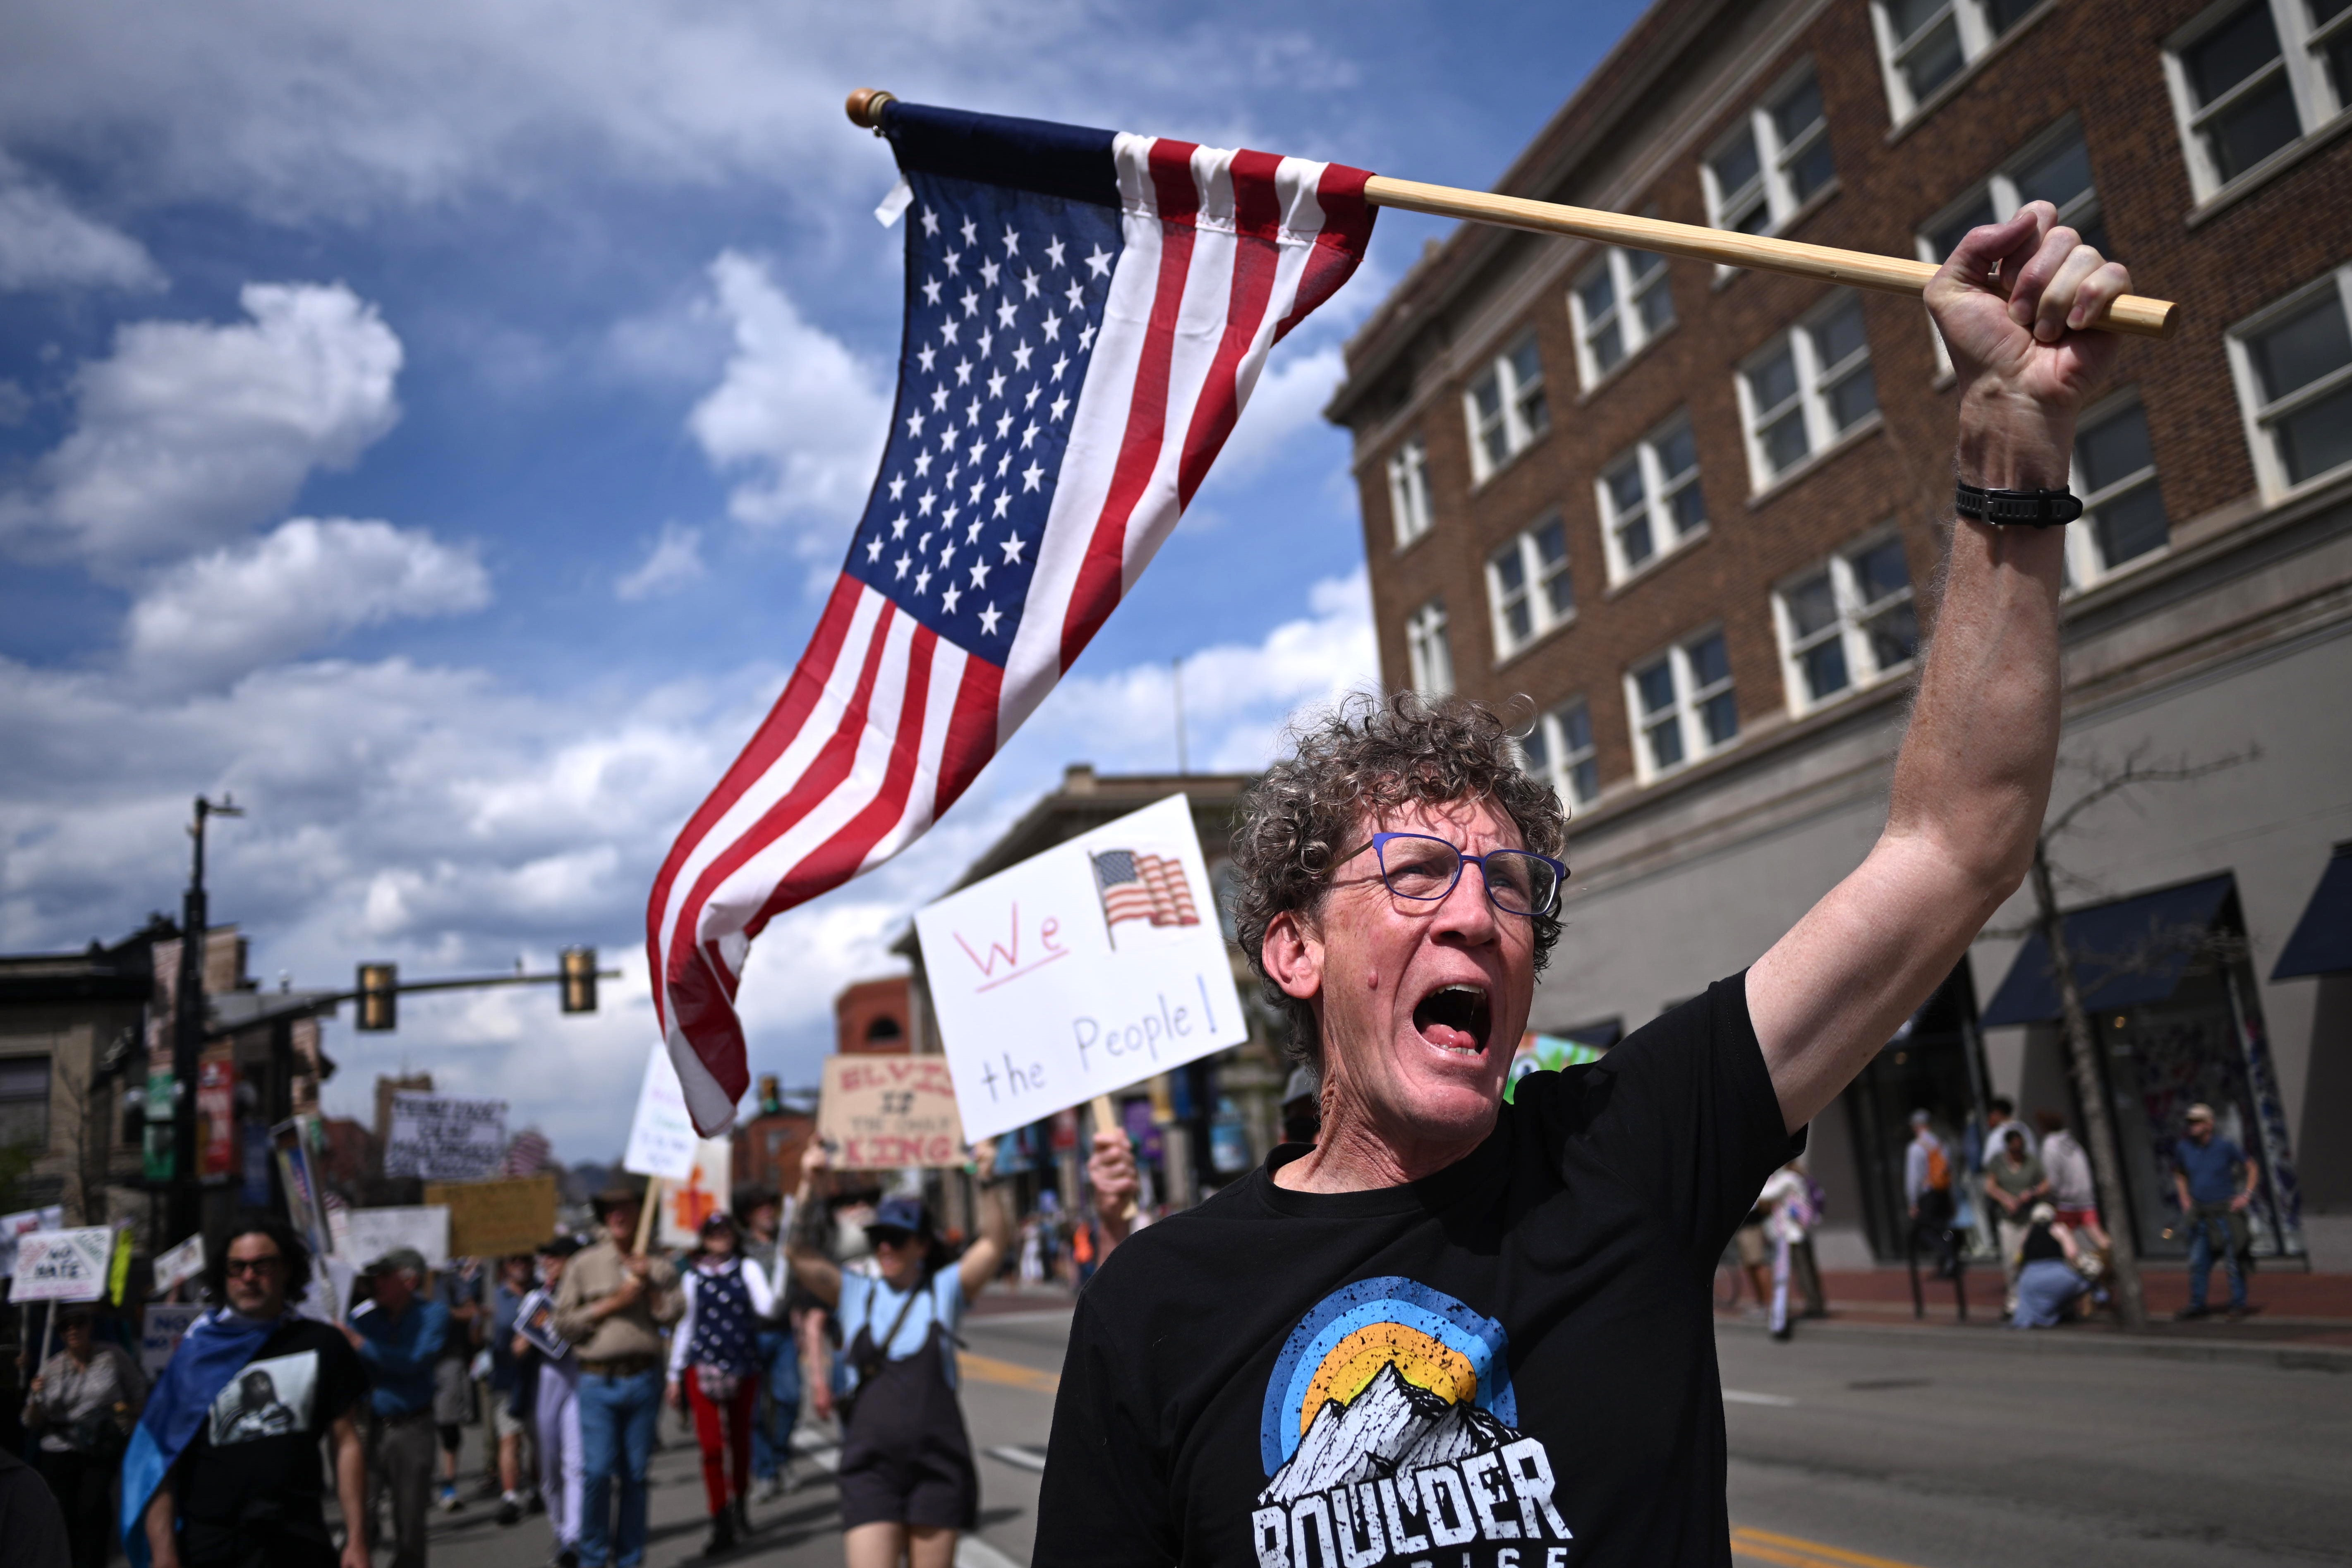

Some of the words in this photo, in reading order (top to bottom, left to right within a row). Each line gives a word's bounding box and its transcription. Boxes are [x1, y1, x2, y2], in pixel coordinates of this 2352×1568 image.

[953, 901, 1061, 977] We
[981, 1051, 1046, 1103] the
[1073, 973, 1217, 1073] People!
[845, 1135, 952, 1166] KING
[1252, 1437, 1574, 1568] BOULDER
